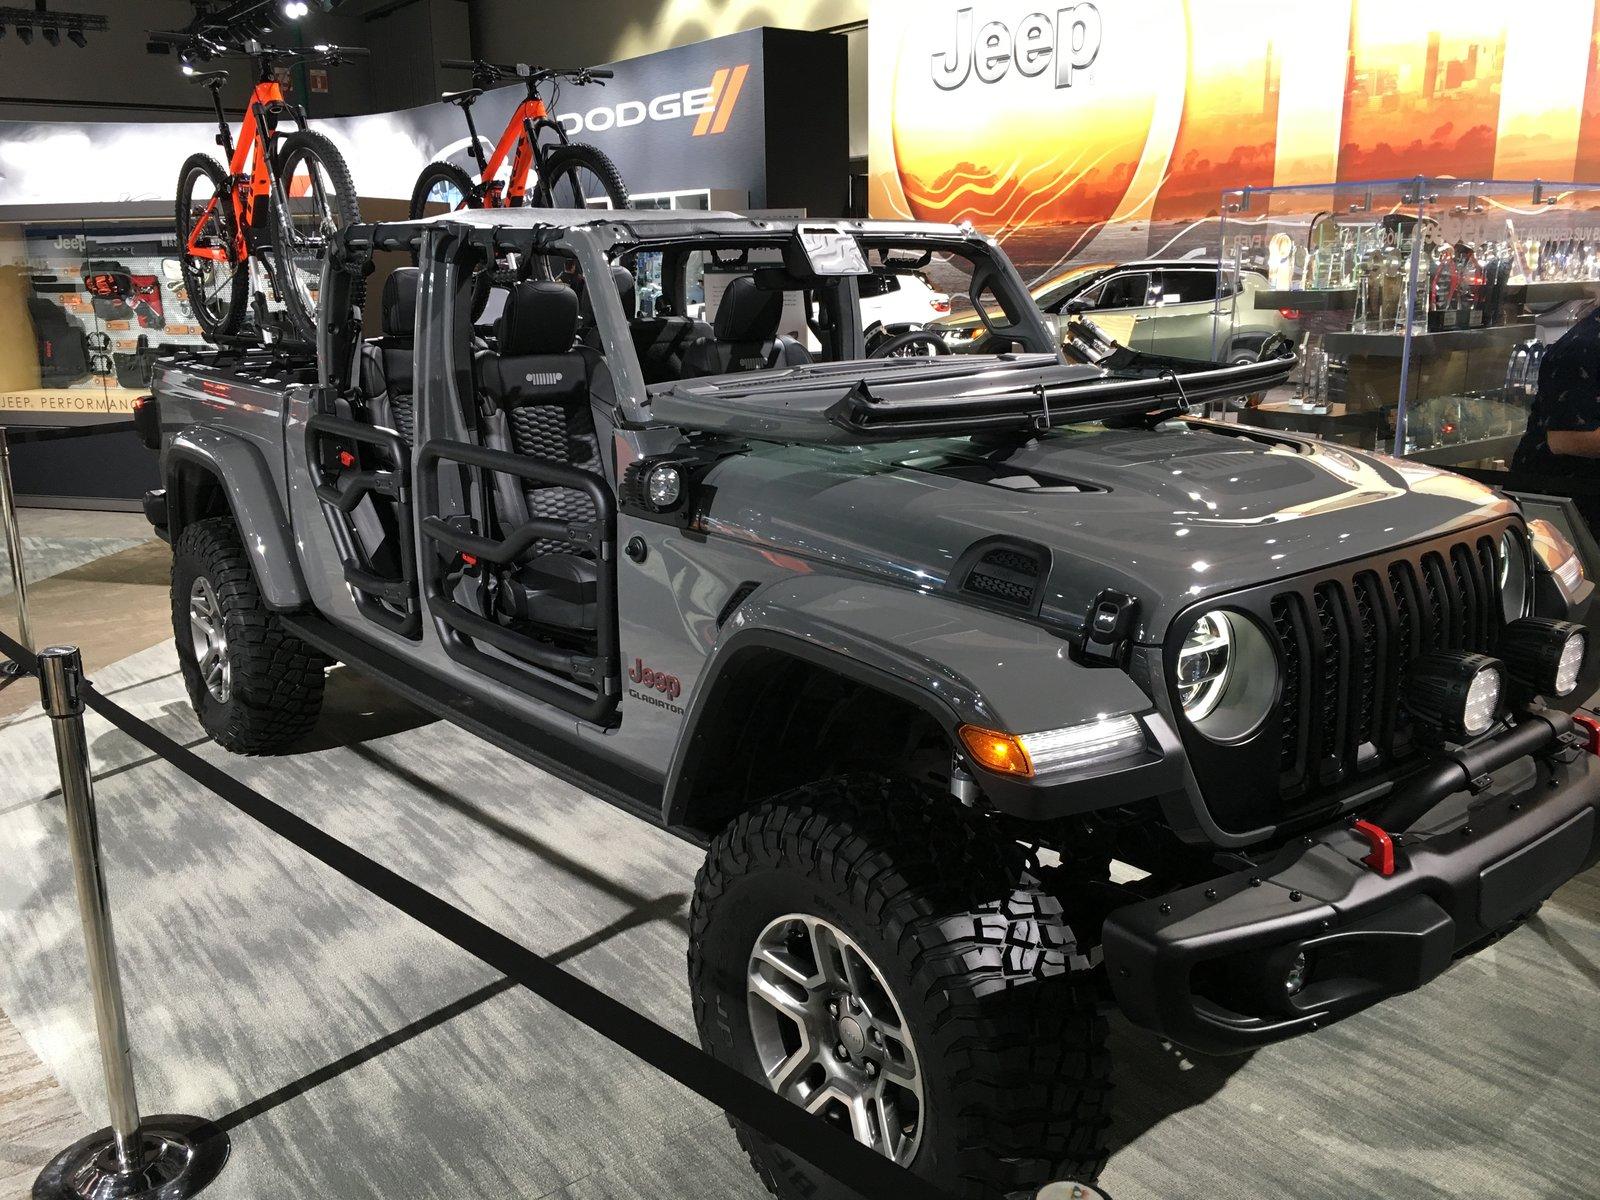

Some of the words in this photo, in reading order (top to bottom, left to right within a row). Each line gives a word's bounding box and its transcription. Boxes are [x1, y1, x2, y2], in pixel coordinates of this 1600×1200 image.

[930, 2, 1103, 91] Jeep
[556, 87, 716, 136] DODGE
[53, 235, 87, 252] Jeep
[1, 396, 30, 408] JEEP
[628, 658, 681, 702] Jeep
[629, 688, 685, 716] GLADIATOR
